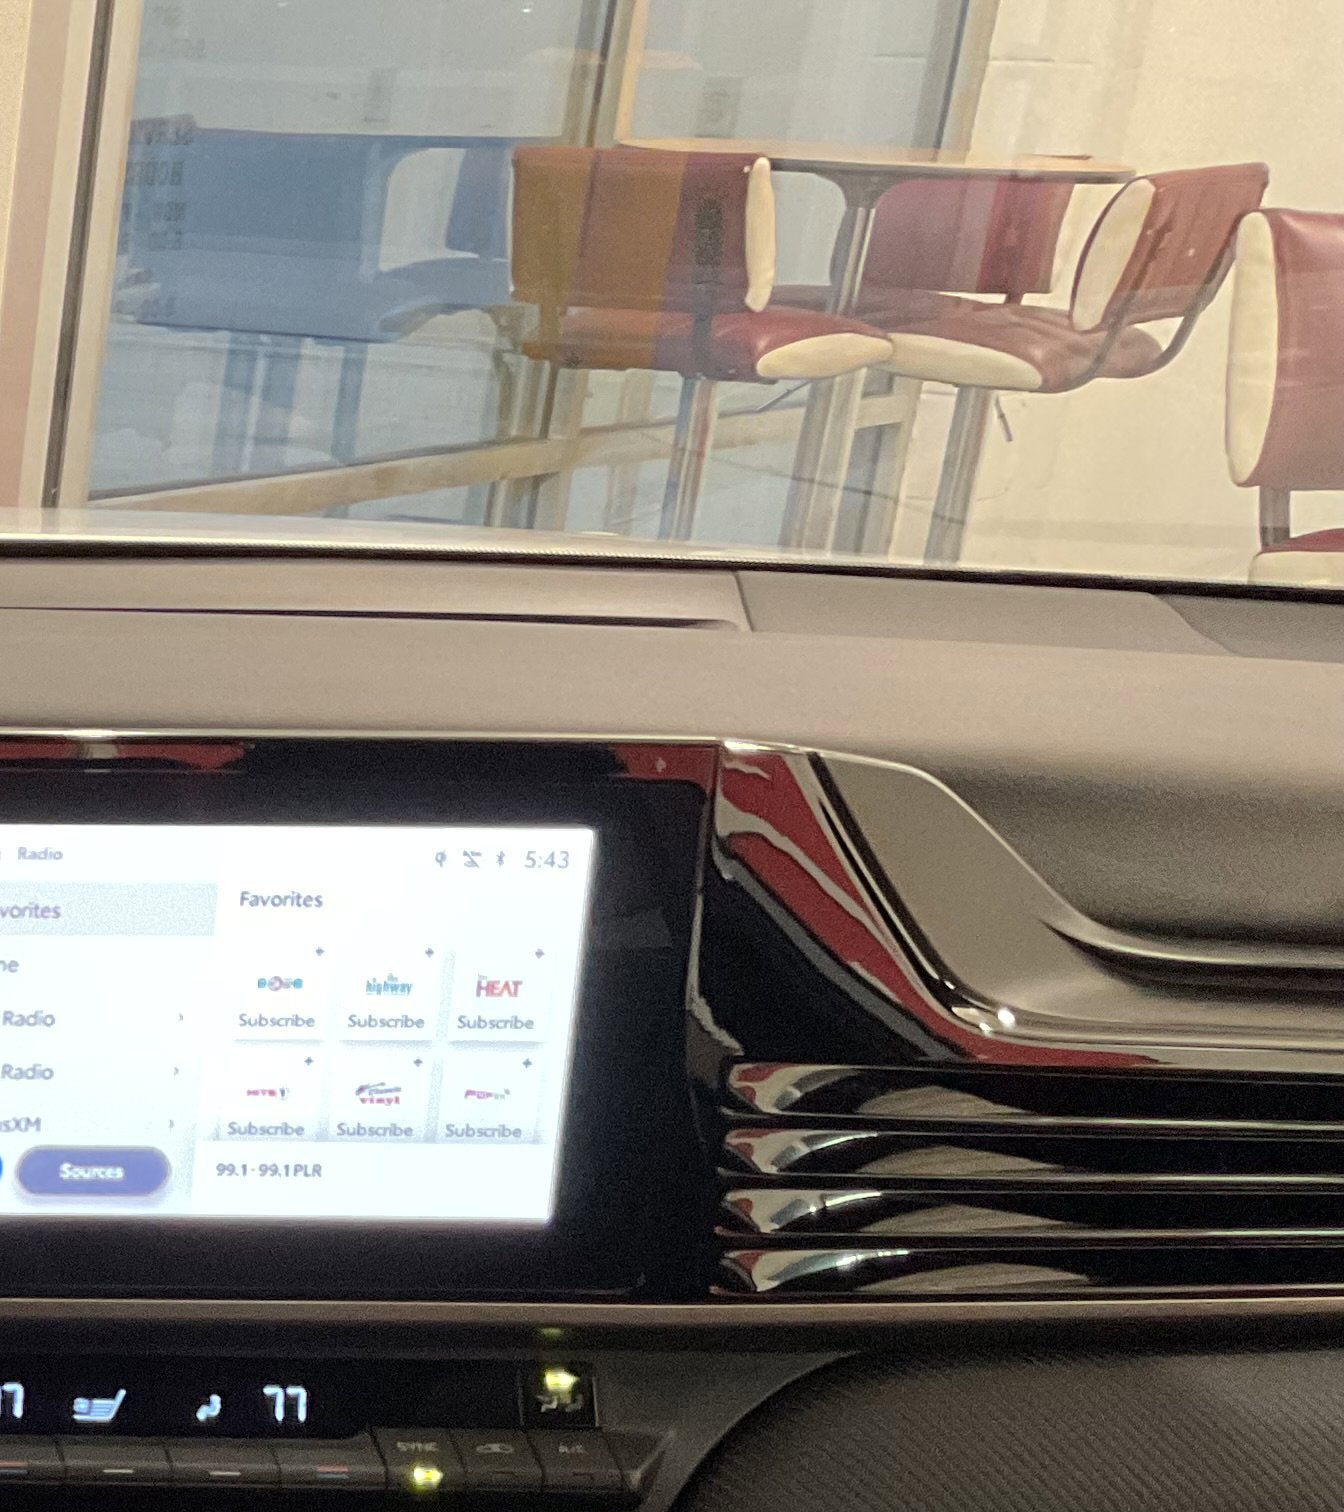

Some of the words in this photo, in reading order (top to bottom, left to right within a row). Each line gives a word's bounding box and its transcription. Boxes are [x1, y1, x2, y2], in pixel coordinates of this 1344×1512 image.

[17, 846, 63, 862] Radio
[523, 851, 571, 870] 5:43
[239, 890, 324, 908] Favorites
[365, 976, 413, 996] highway
[475, 979, 523, 998] HEAT
[2, 1010, 56, 1028] Radio
[238, 1013, 315, 1028] Subscribe
[347, 1014, 425, 1029] Subscribe
[457, 1015, 535, 1030] Subscribe
[1, 1063, 54, 1081] Radio
[227, 1121, 305, 1137] Subscribe
[336, 1122, 414, 1138] Subscribe
[445, 1124, 523, 1139] Subscribe
[59, 1163, 124, 1180] Sources
[215, 1163, 248, 1177] 99.1
[396, 1441, 438, 1453] SYNC
